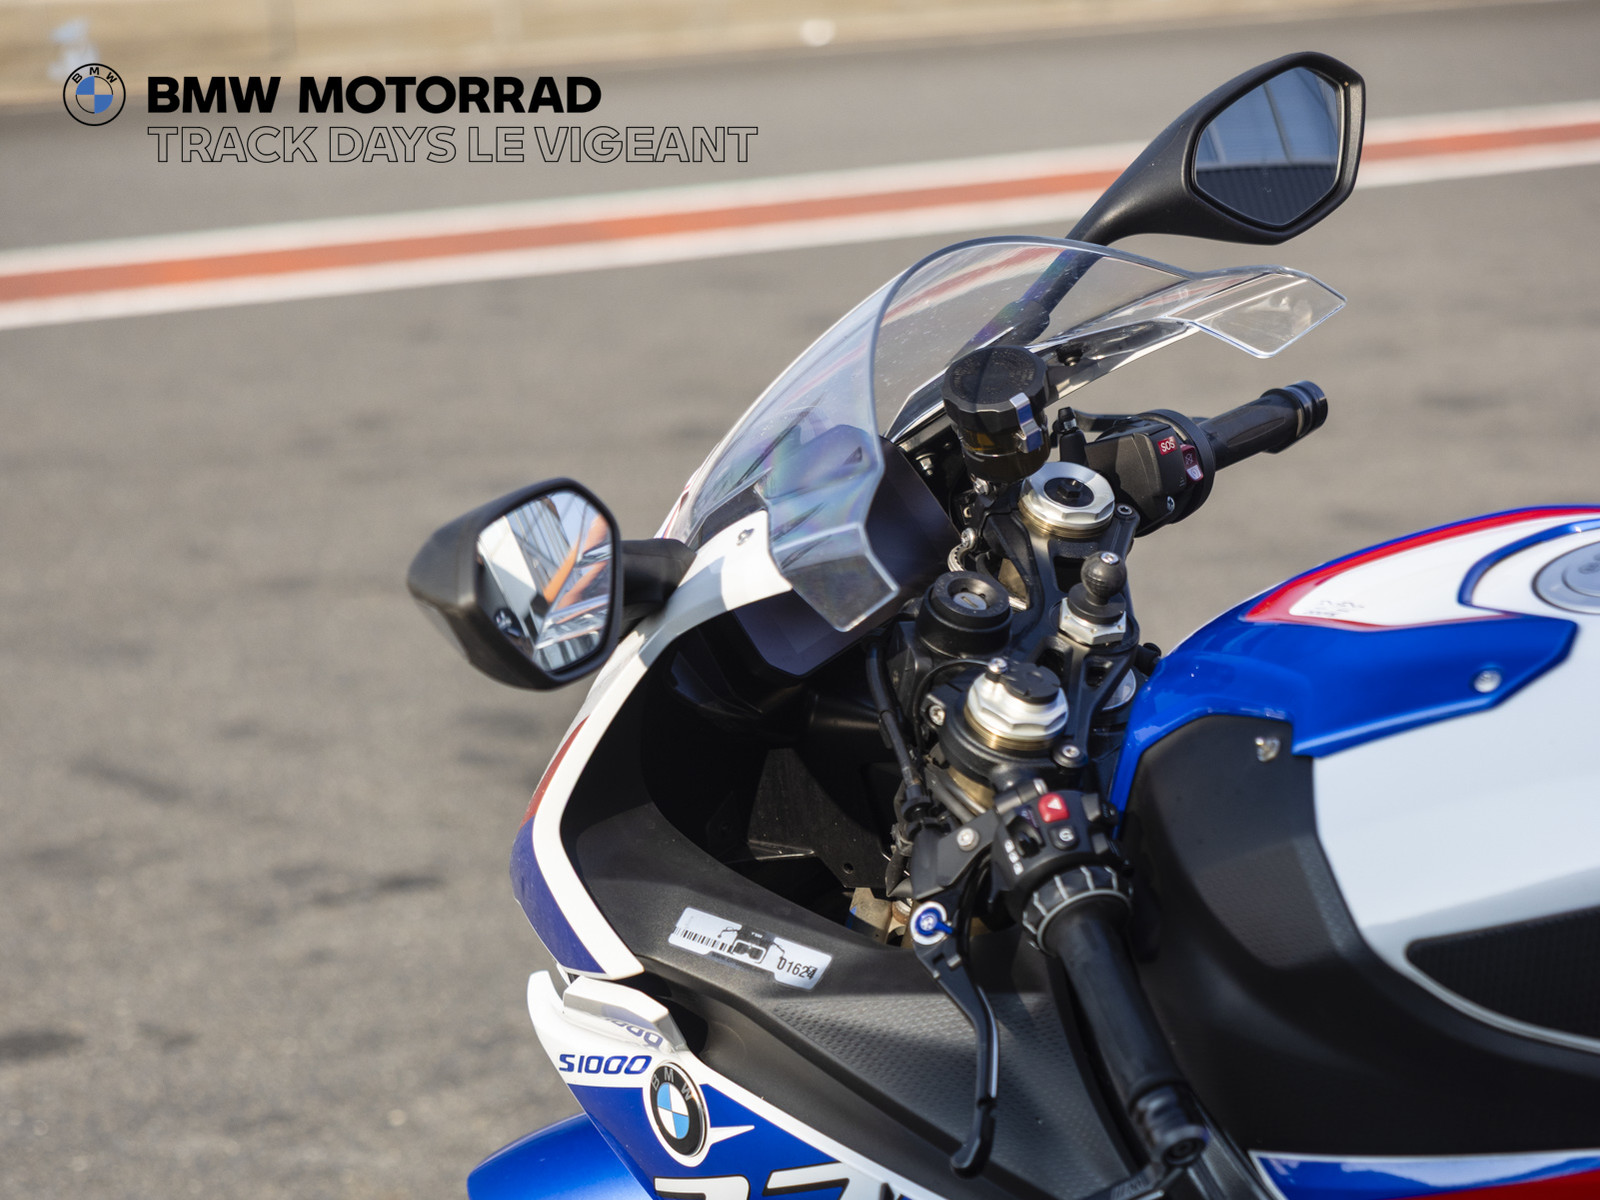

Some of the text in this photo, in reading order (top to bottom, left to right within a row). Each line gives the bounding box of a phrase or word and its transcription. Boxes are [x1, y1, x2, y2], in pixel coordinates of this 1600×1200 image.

[1160, 440, 1176, 452] SOS
[559, 1054, 652, 1074] S1000
[651, 1067, 693, 1101] BMW
